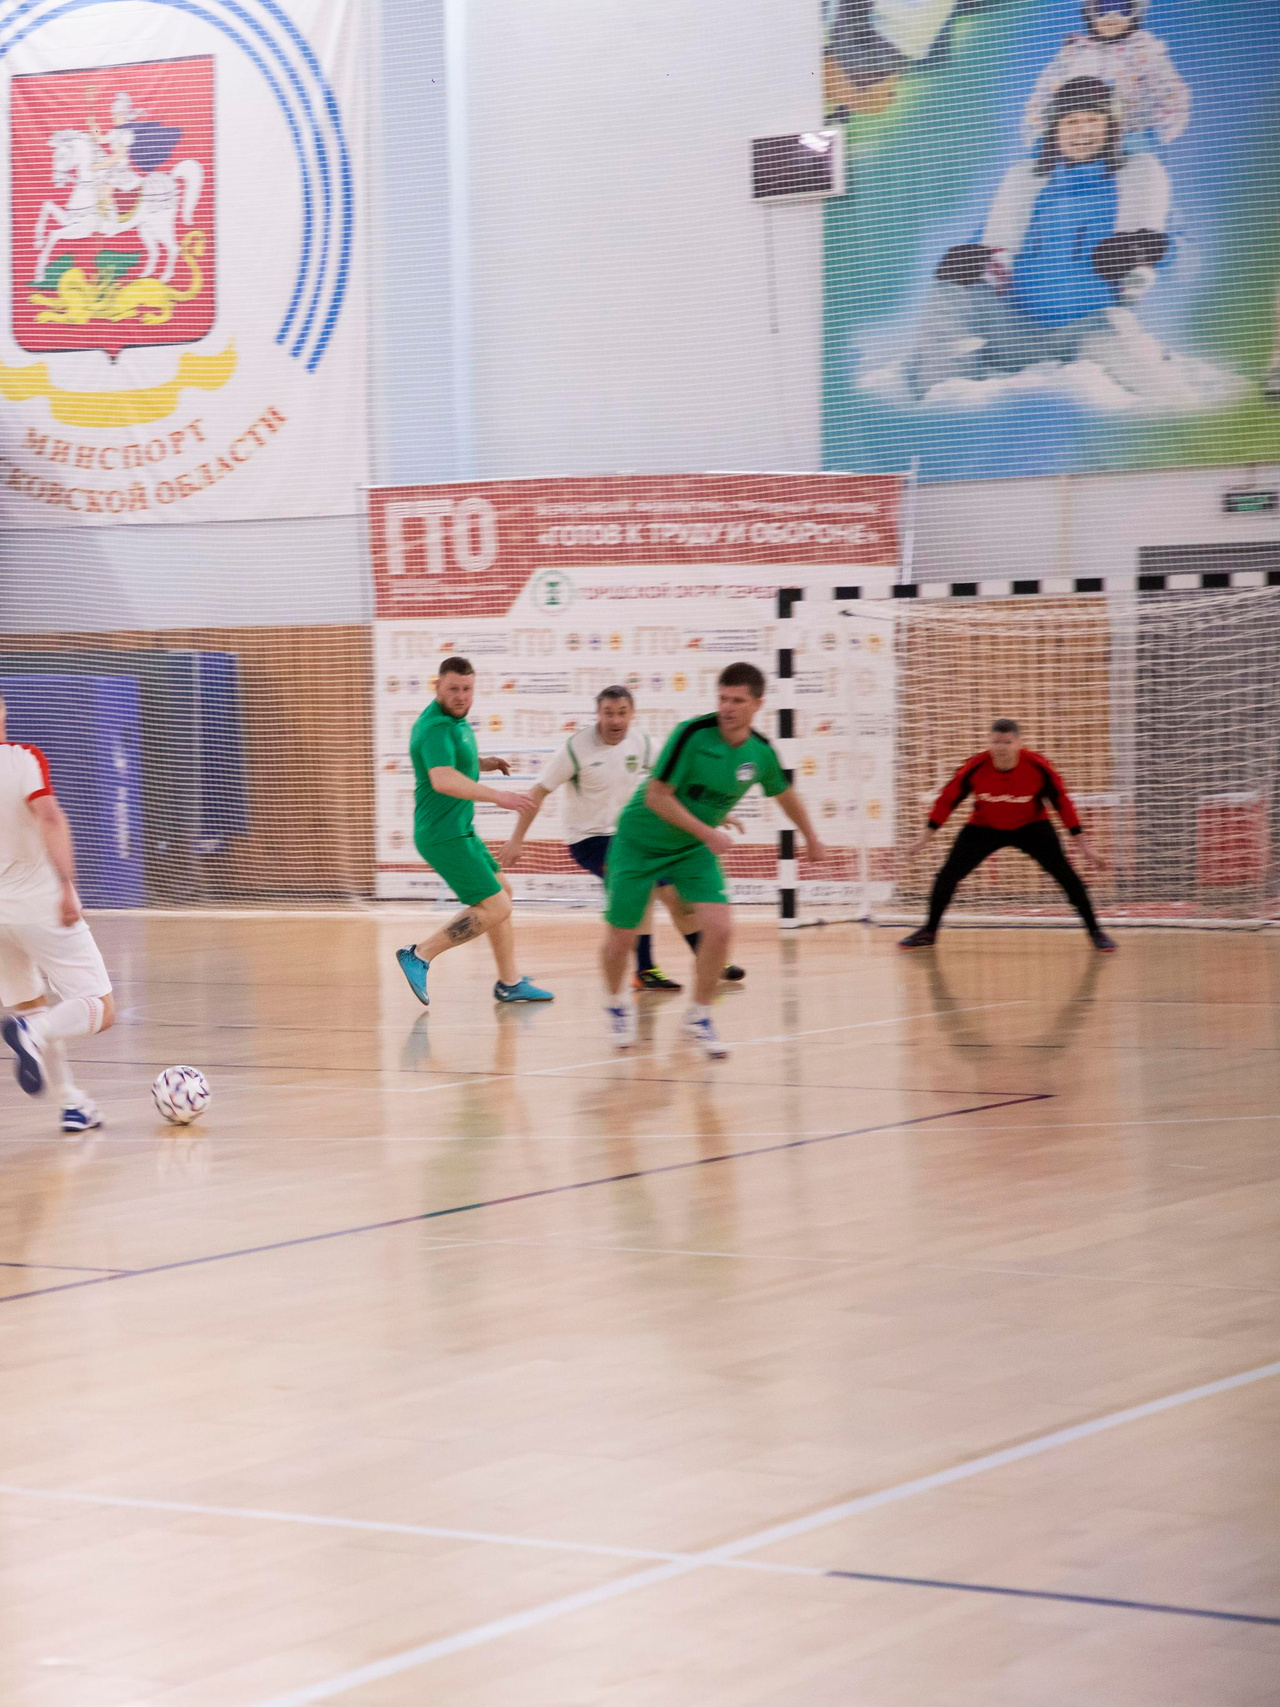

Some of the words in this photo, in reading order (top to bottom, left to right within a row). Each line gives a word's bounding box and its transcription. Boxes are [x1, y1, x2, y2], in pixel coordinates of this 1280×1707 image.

[20, 418, 206, 470] МИНСПОРТ
[154, 405, 288, 504] ОБЛАСТИ
[626, 523, 645, 545] К
